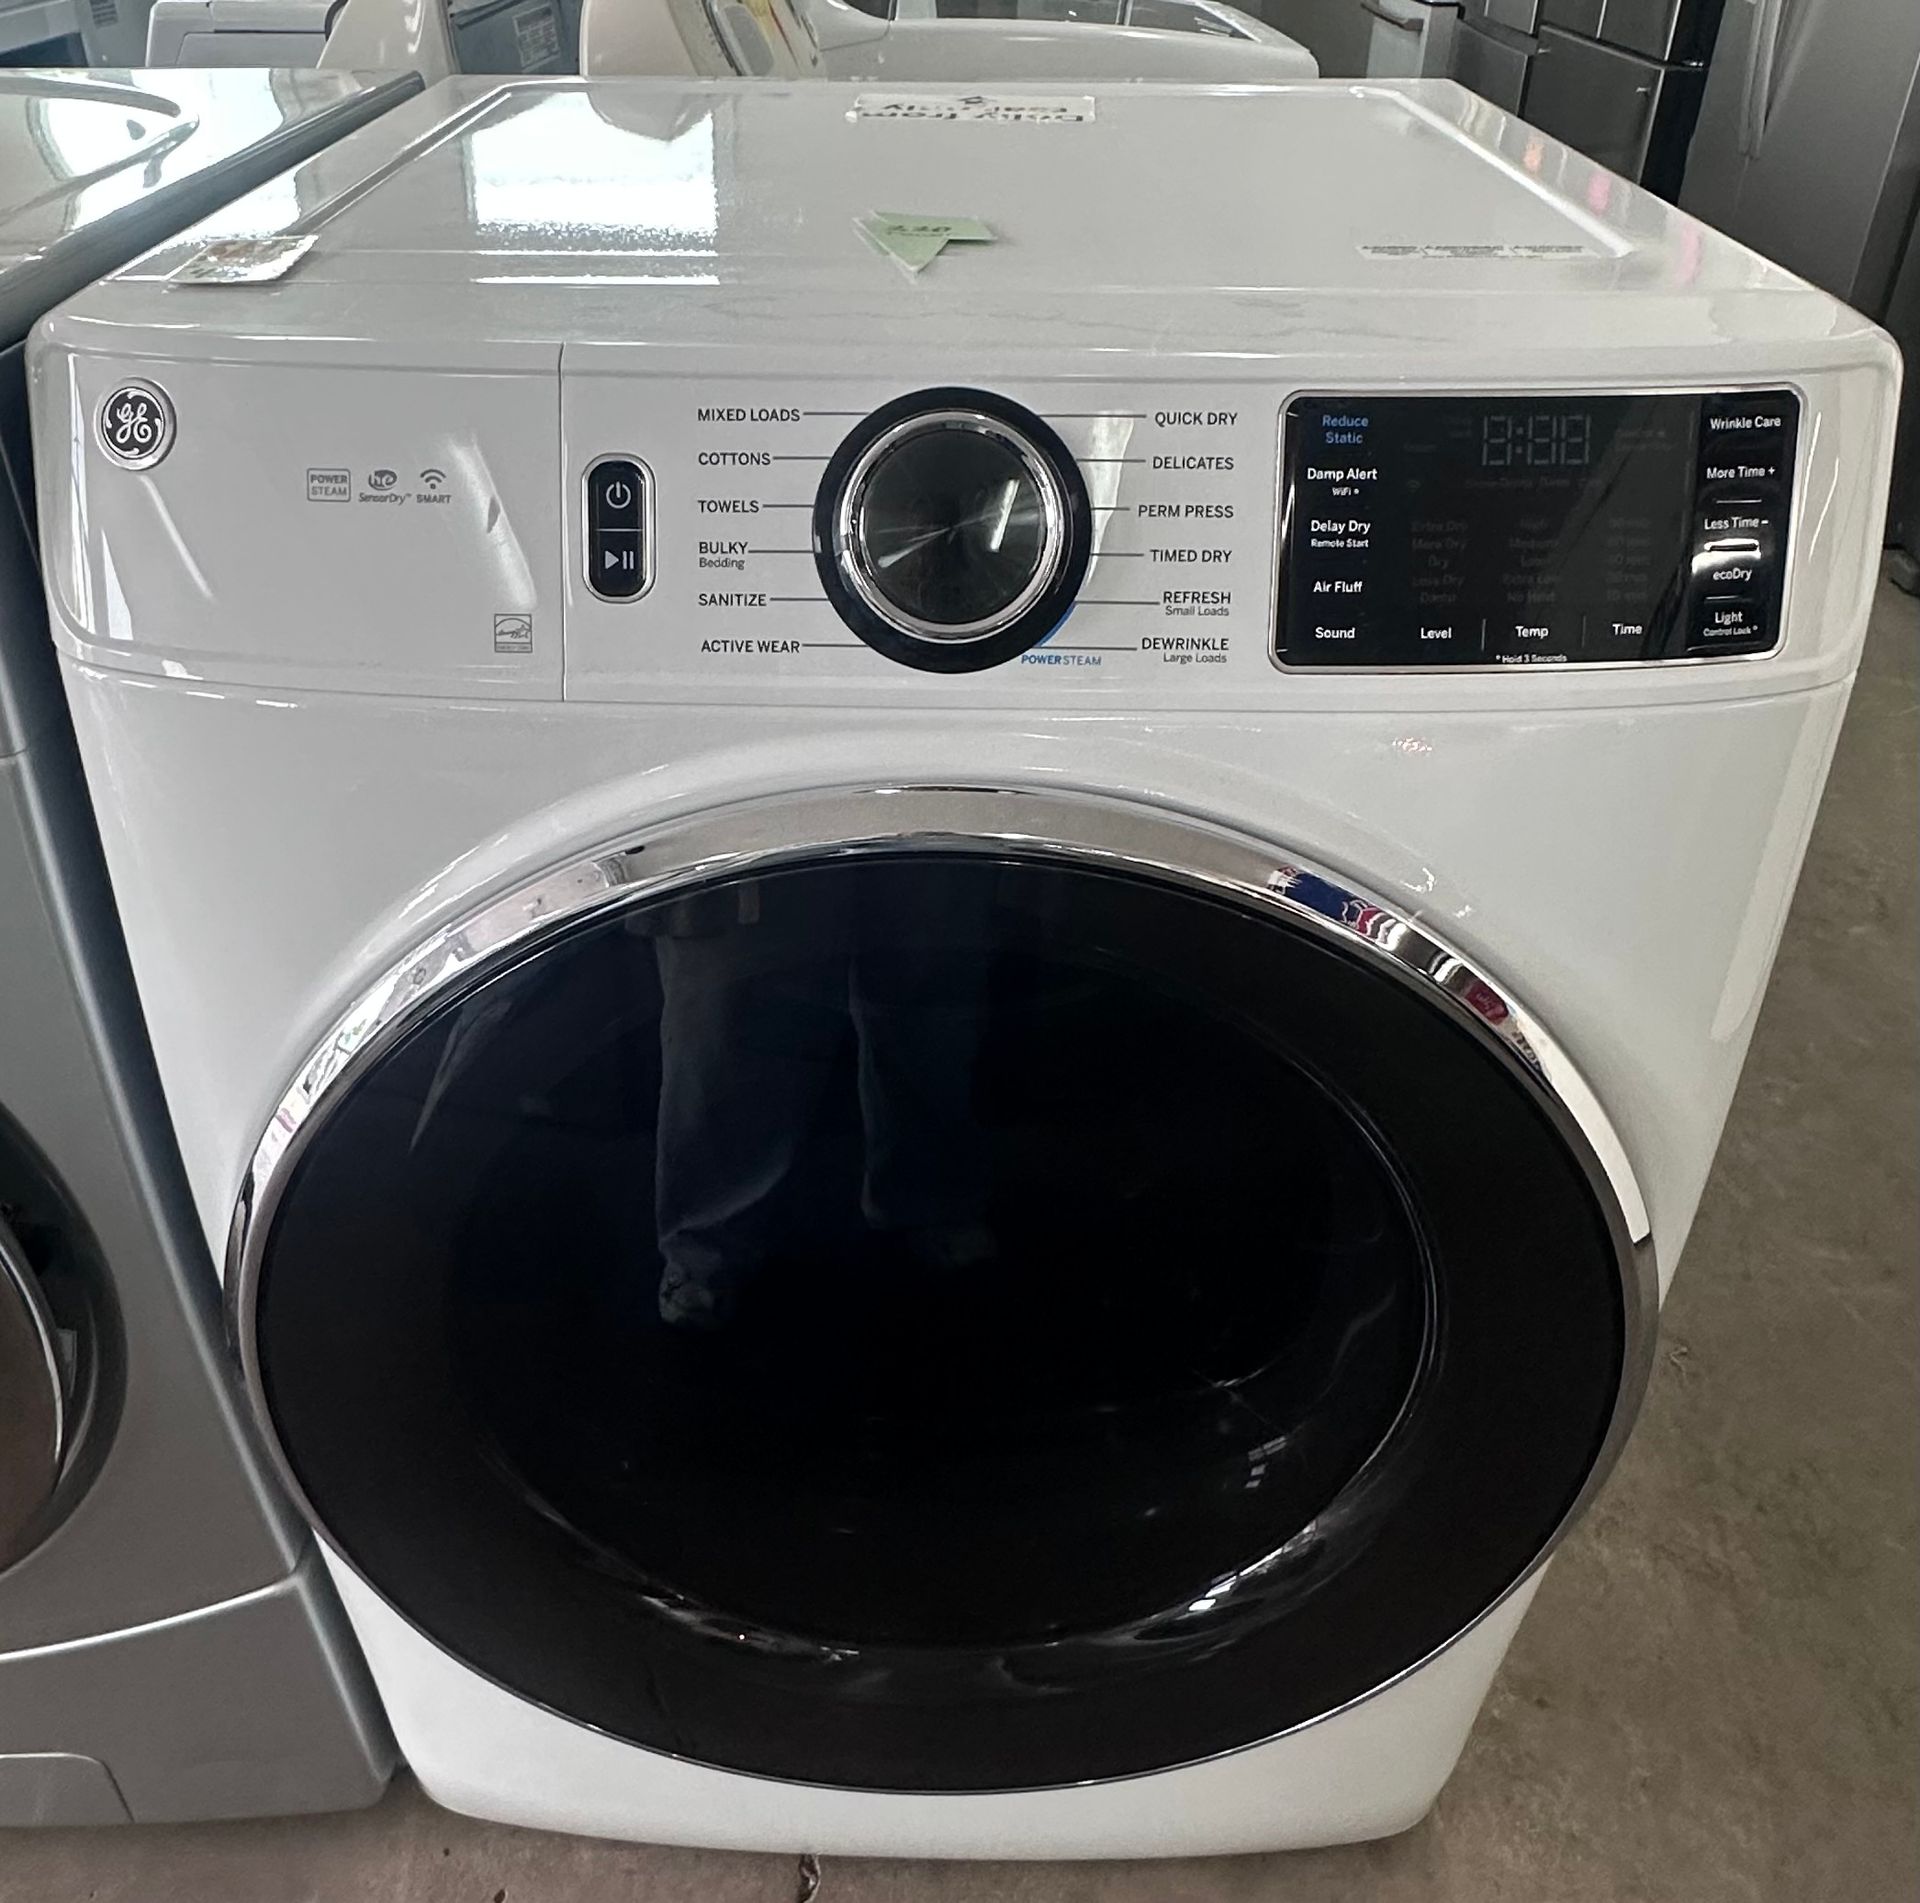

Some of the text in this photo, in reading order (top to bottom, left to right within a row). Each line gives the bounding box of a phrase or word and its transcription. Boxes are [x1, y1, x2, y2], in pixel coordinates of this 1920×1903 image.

[697, 408, 801, 422] MIXED LOADS
[1154, 411, 1238, 428] QUICK DRY
[1322, 414, 1369, 427] Reduce
[1710, 415, 1781, 430] Wrinkle Care
[1326, 431, 1363, 444] Static
[698, 452, 771, 466] COTTONS
[1152, 456, 1235, 470] DELICATES
[310, 474, 348, 484] POWER
[1307, 467, 1378, 483] Damp Alert
[1706, 466, 1735, 479] More
[1738, 465, 1766, 478] Time
[311, 486, 347, 496] STEAM
[416, 494, 452, 504] SMART
[697, 500, 760, 513] TOWELS
[1138, 504, 1235, 518] PERM PRESS
[1310, 519, 1371, 535] Delay Dry
[1704, 518, 1730, 531] Less
[1731, 516, 1760, 529] Time
[699, 541, 749, 555] BULKY
[1310, 538, 1369, 548] Remote Start
[1150, 549, 1233, 563] TIMED DRY
[699, 557, 746, 571] Bedding
[1712, 567, 1753, 582] ecoDry
[1312, 580, 1363, 593] Air Fluff
[698, 593, 767, 607] SANITIZE
[1163, 591, 1232, 604] REFRESH
[1165, 605, 1230, 617] Small Loads
[1714, 611, 1743, 626] Light
[1315, 626, 1356, 639] Sound
[1420, 627, 1452, 639] Level
[1515, 625, 1549, 639] Temp
[1612, 623, 1643, 635] Time
[701, 639, 801, 653] ACTIVE WEAR
[1141, 637, 1230, 651] DEWRINKLE
[1163, 653, 1228, 665] Large Loads
[1523, 654, 1530, 663] 3
